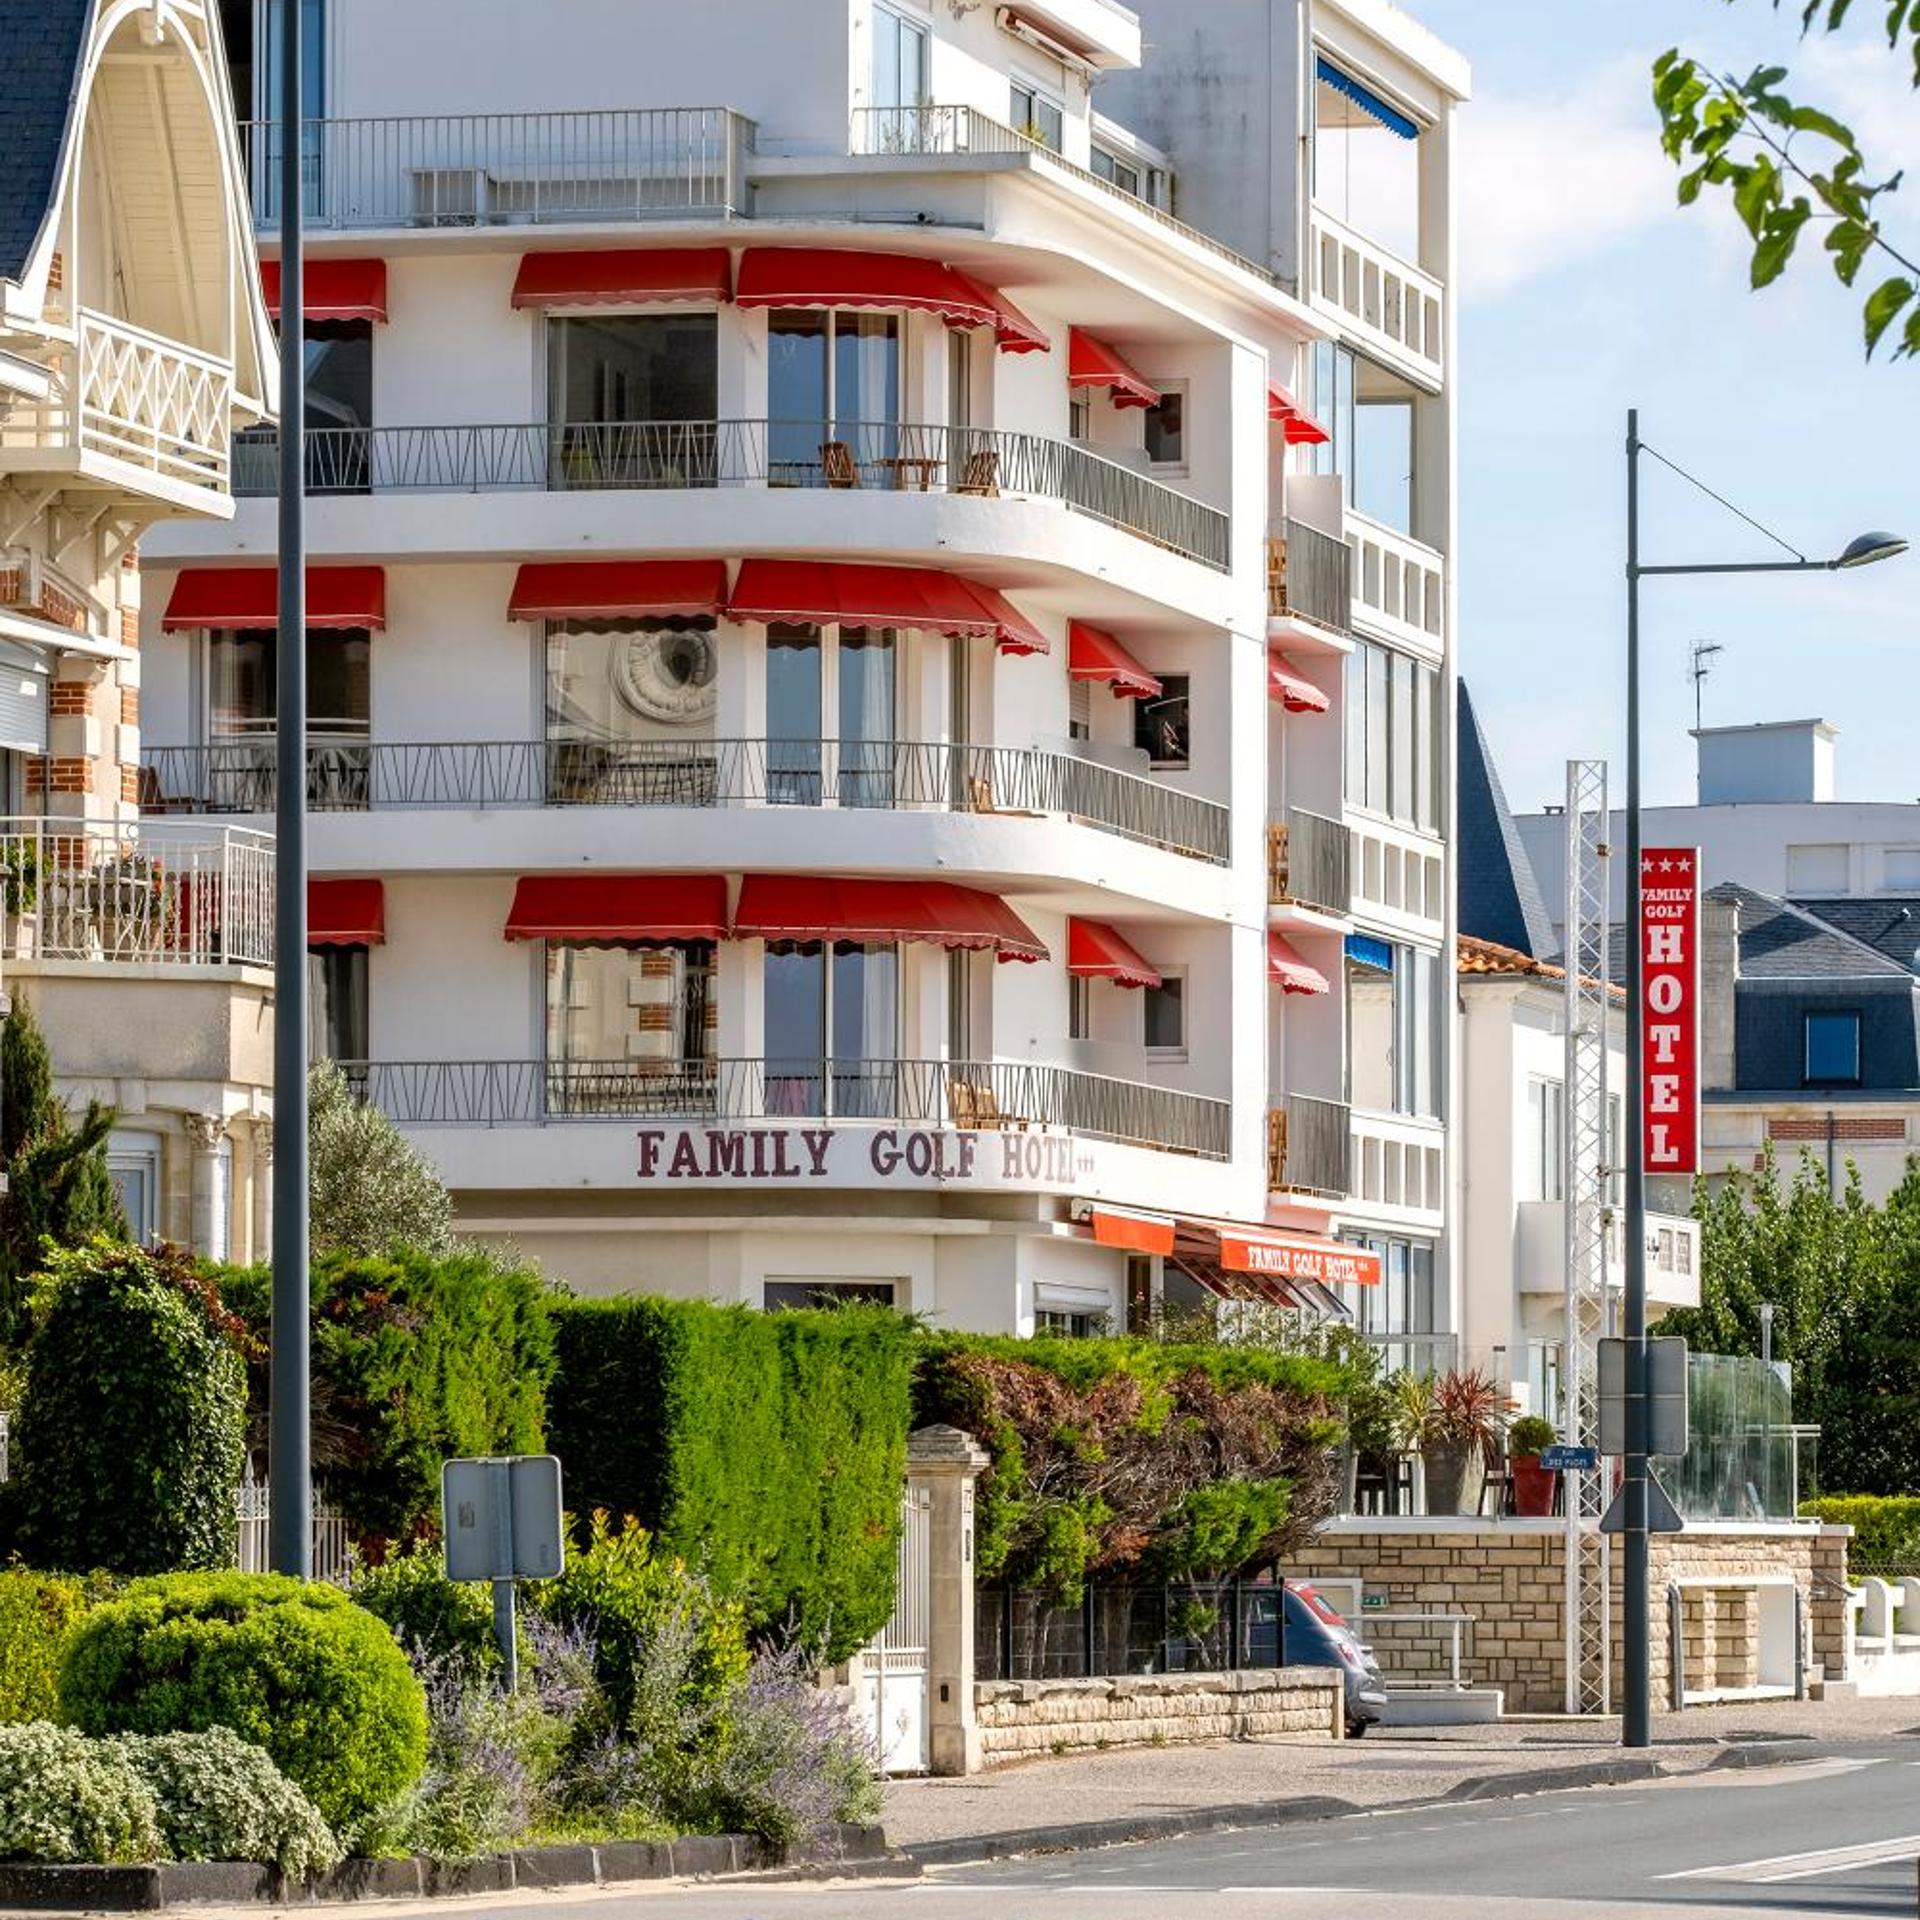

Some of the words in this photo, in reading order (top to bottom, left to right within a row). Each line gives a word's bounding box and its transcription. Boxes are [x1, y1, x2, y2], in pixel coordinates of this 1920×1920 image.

[1640, 888, 1693, 902] FAMILY
[1644, 904, 1686, 918] GOLF
[1647, 924, 1684, 1163] HOTEL
[637, 1130, 835, 1177] FAMILY
[870, 1130, 978, 1177] GOLF
[1001, 1133, 1076, 1183] HOTEL
[1247, 1245, 1290, 1272] FAMILY
[1293, 1252, 1322, 1276] GOLF
[1325, 1256, 1358, 1281] HOTEL
